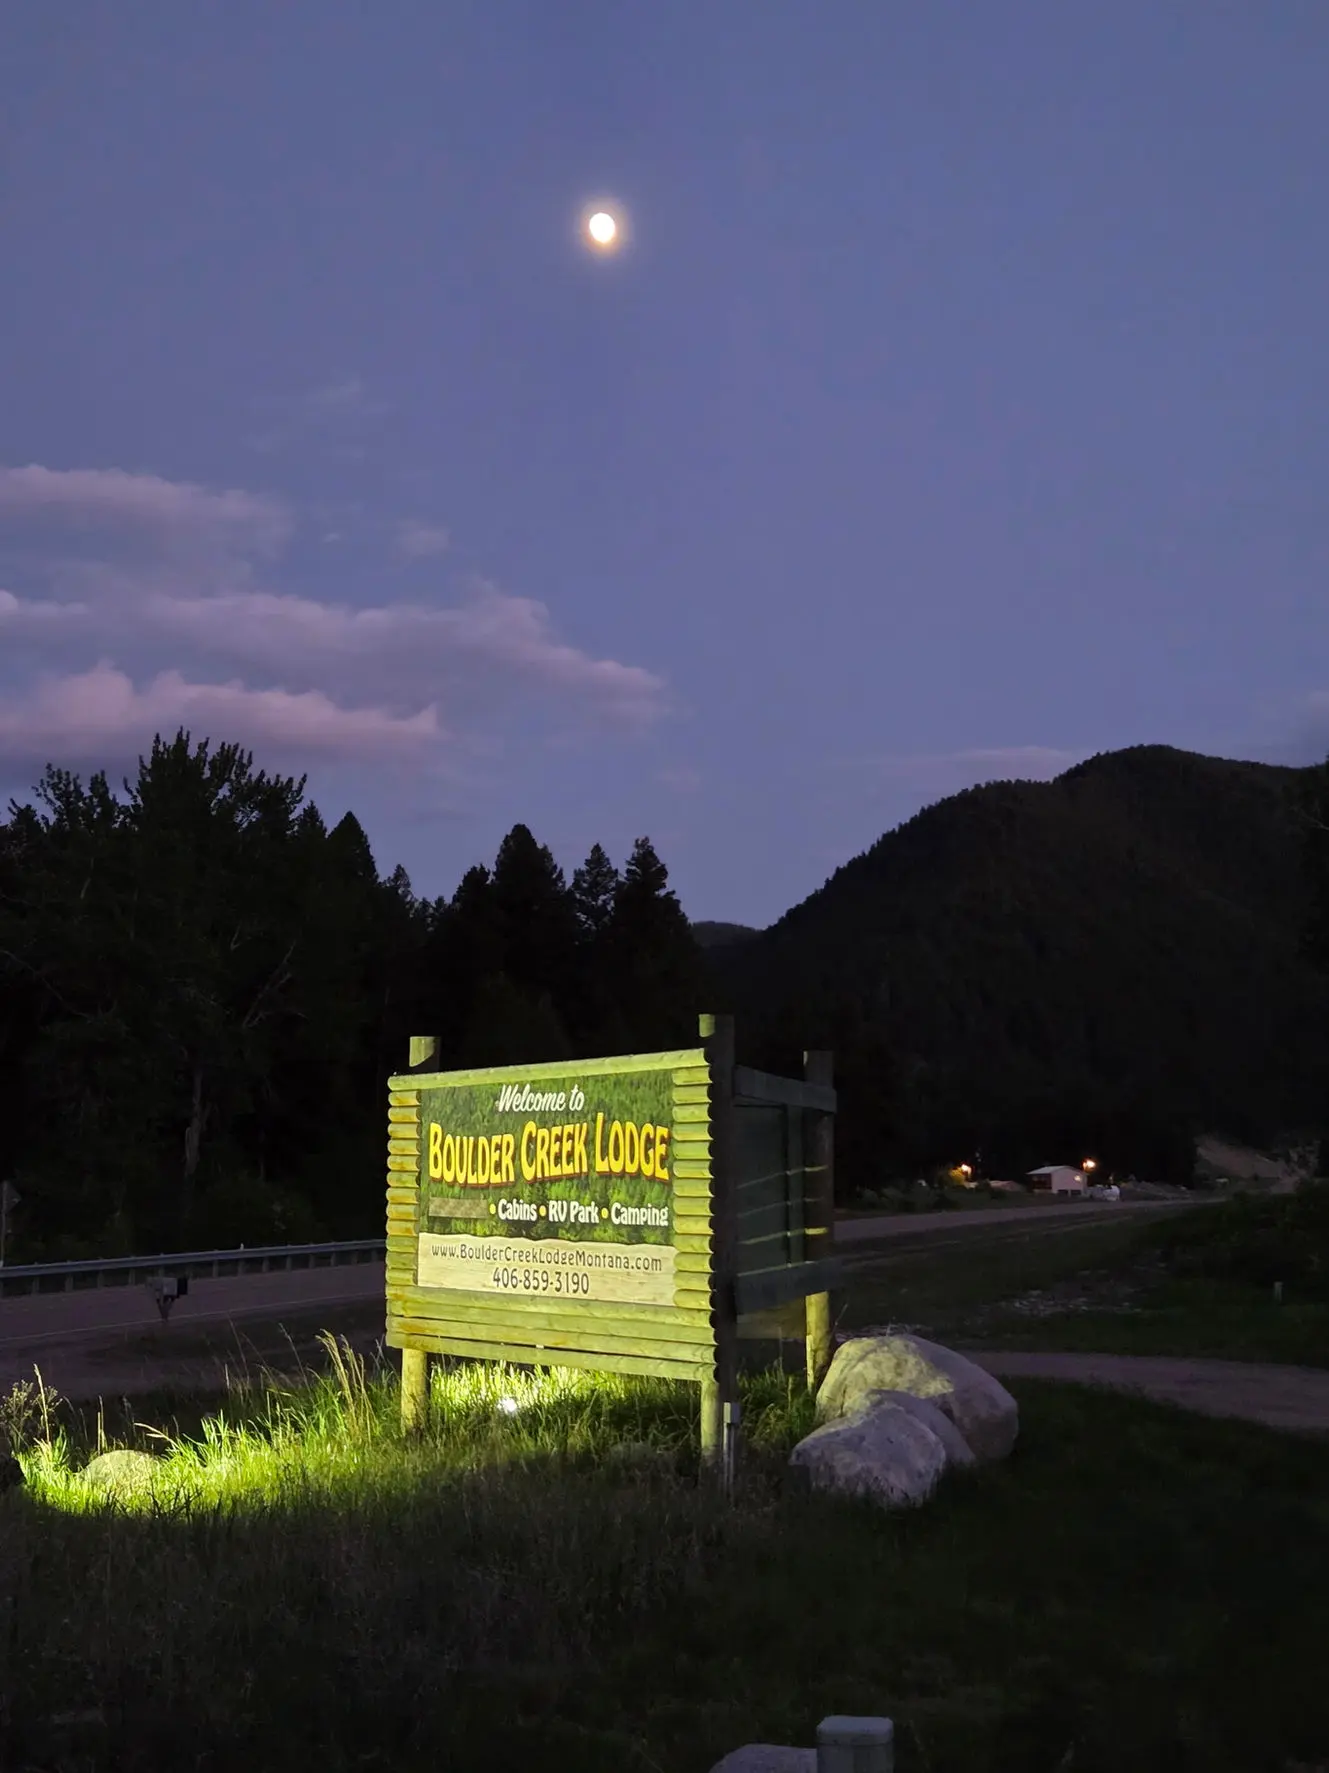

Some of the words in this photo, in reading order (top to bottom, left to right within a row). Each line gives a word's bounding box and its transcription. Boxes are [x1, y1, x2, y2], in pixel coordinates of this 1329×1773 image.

[497, 1083, 566, 1112] Welcome
[569, 1083, 585, 1112] to
[428, 1122, 516, 1187] BOULDER
[520, 1120, 588, 1183] CREEK
[595, 1112, 671, 1184] LODGE
[497, 1198, 537, 1222] Cabins
[548, 1200, 568, 1222] RV
[569, 1201, 600, 1225] Park
[611, 1202, 669, 1226] Camping
[431, 1244, 662, 1272] www.BoulderCreekLodgeMontana.com
[492, 1267, 590, 1295] 406-859-3190
